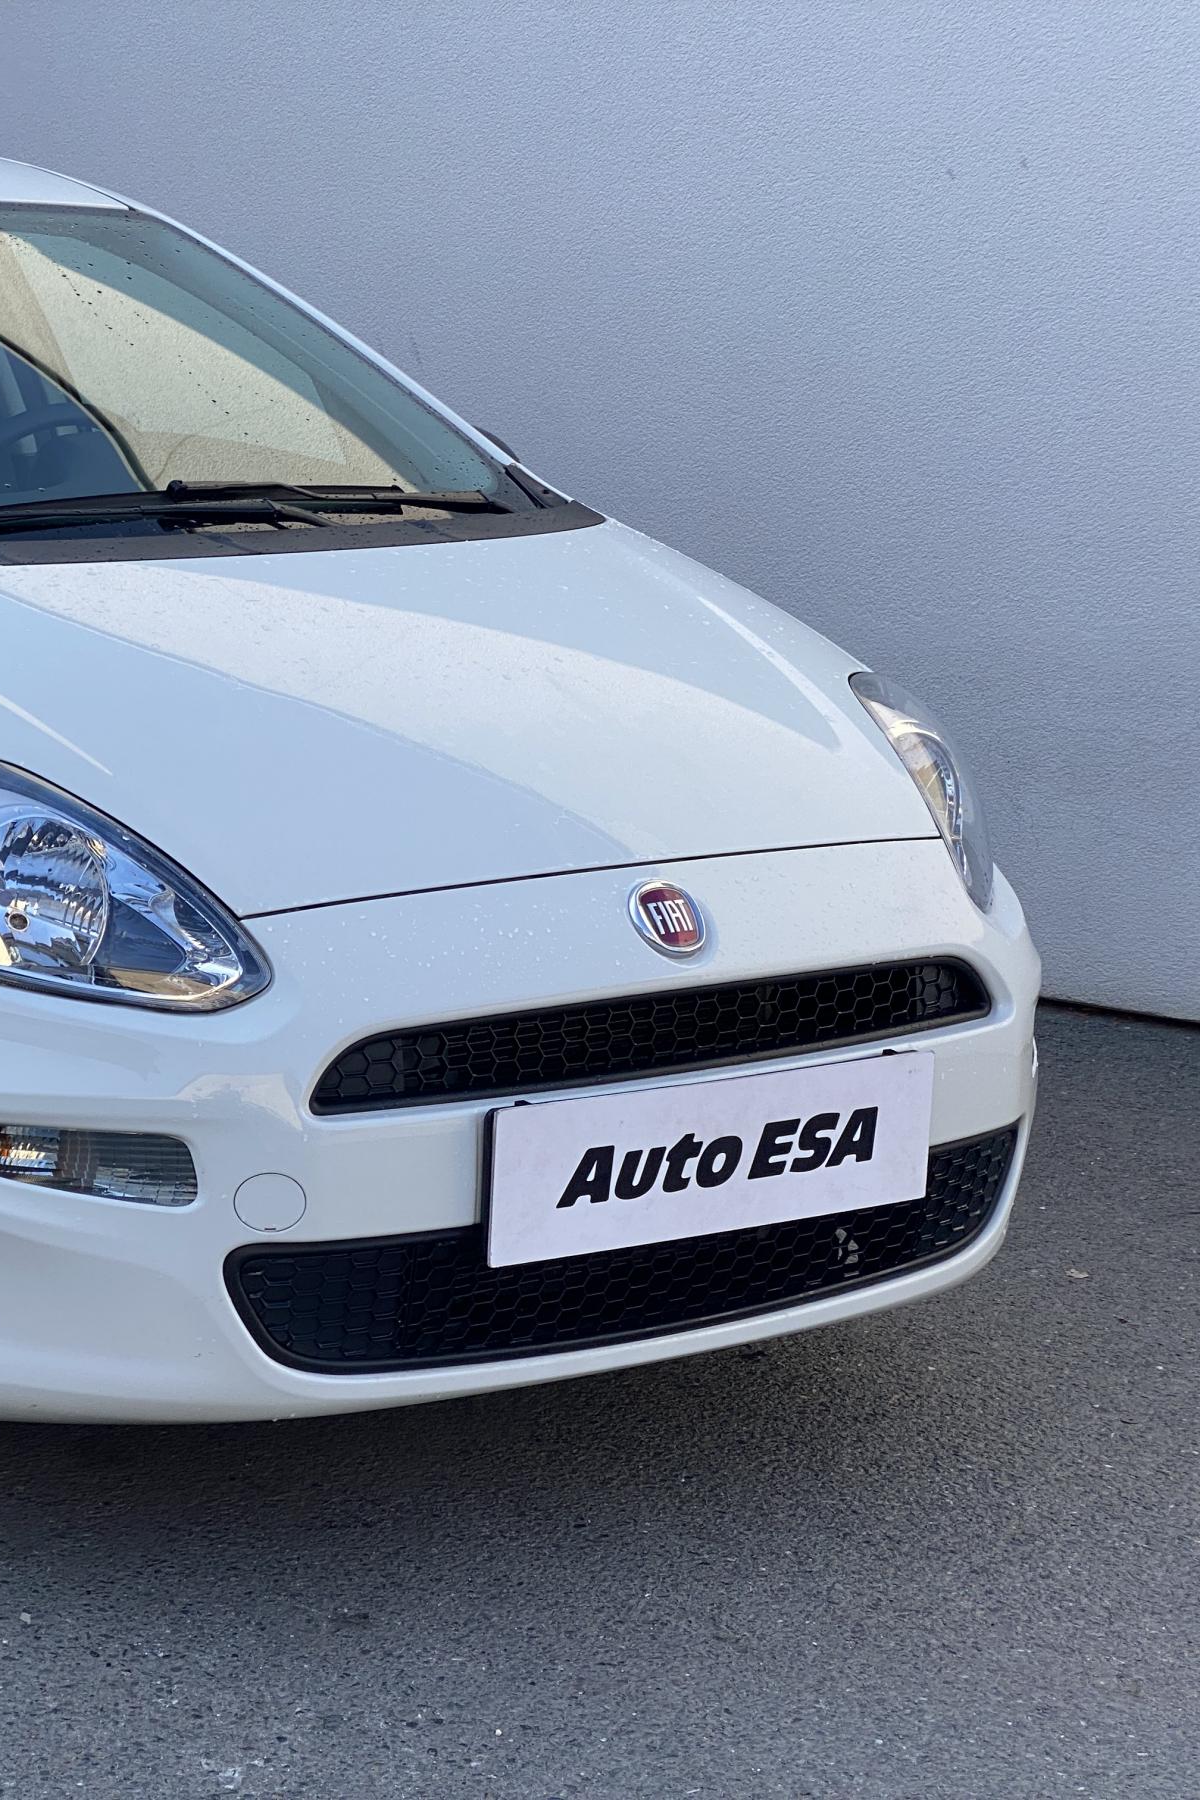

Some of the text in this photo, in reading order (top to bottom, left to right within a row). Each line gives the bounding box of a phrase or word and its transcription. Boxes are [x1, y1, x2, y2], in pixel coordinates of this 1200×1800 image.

[646, 899, 694, 935] FIAT
[556, 1106, 879, 1208] Auto ESA
